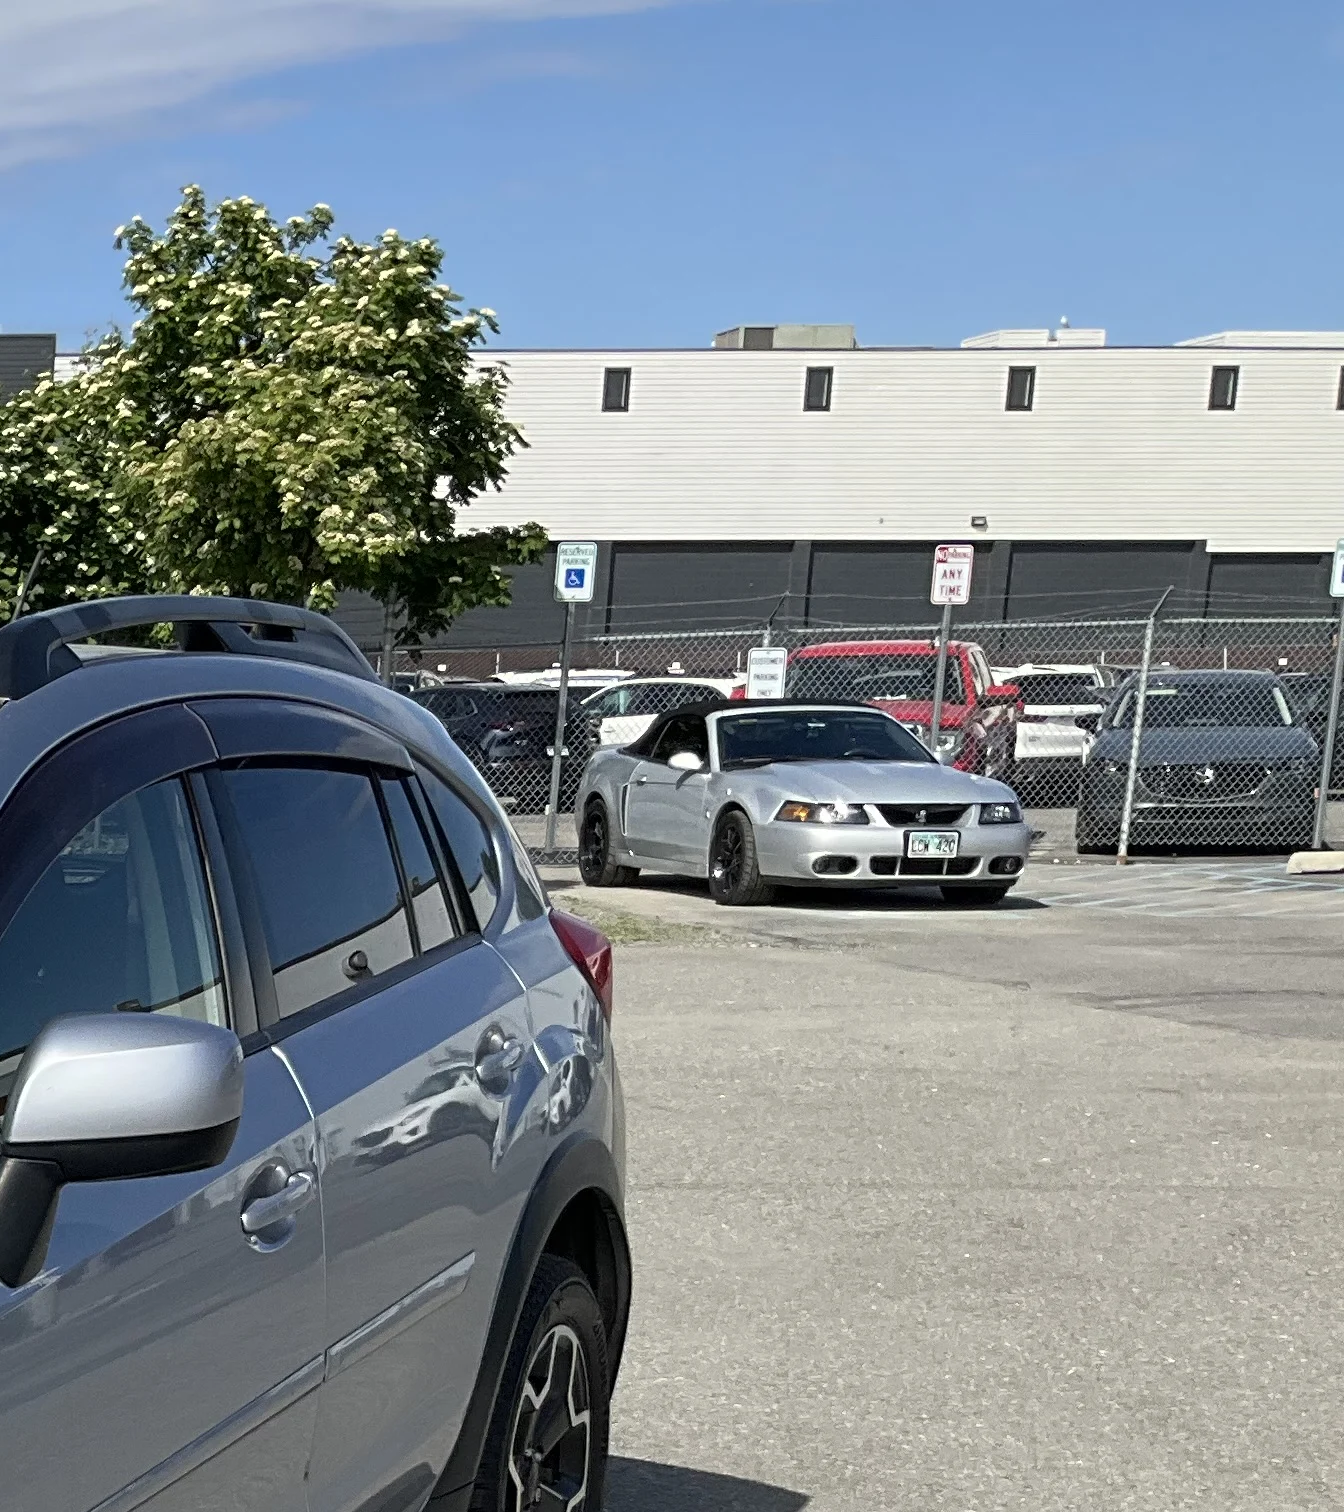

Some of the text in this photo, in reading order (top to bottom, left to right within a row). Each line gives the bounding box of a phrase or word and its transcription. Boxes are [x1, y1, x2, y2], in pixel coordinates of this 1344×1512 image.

[560, 548, 594, 556] RESERVED
[937, 549, 948, 561] NO
[941, 569, 963, 580] ANY
[940, 585, 962, 597] TIME
